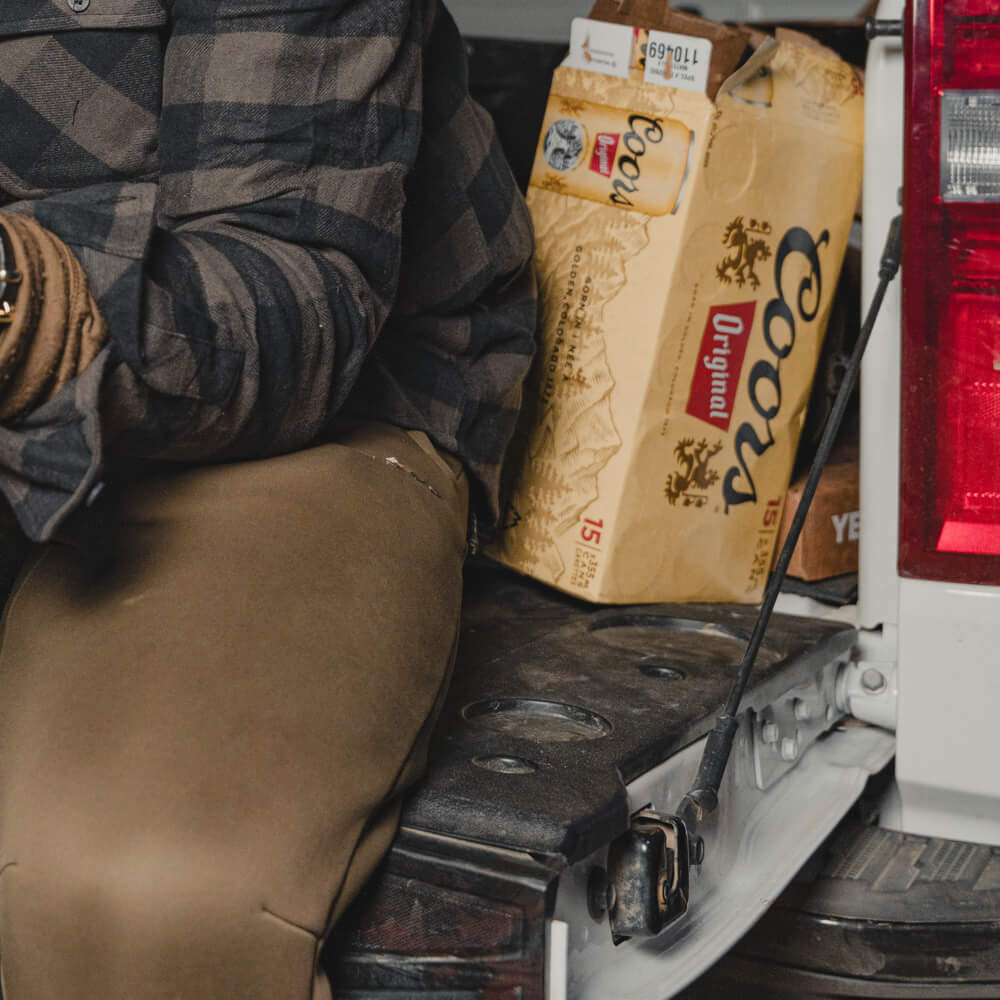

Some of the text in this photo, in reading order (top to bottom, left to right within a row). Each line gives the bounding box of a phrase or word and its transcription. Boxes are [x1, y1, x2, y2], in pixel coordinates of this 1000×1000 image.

[609, 114, 664, 207] Coors
[703, 313, 745, 420] Original
[723, 226, 830, 516] Coors
[581, 518, 603, 545] 15
